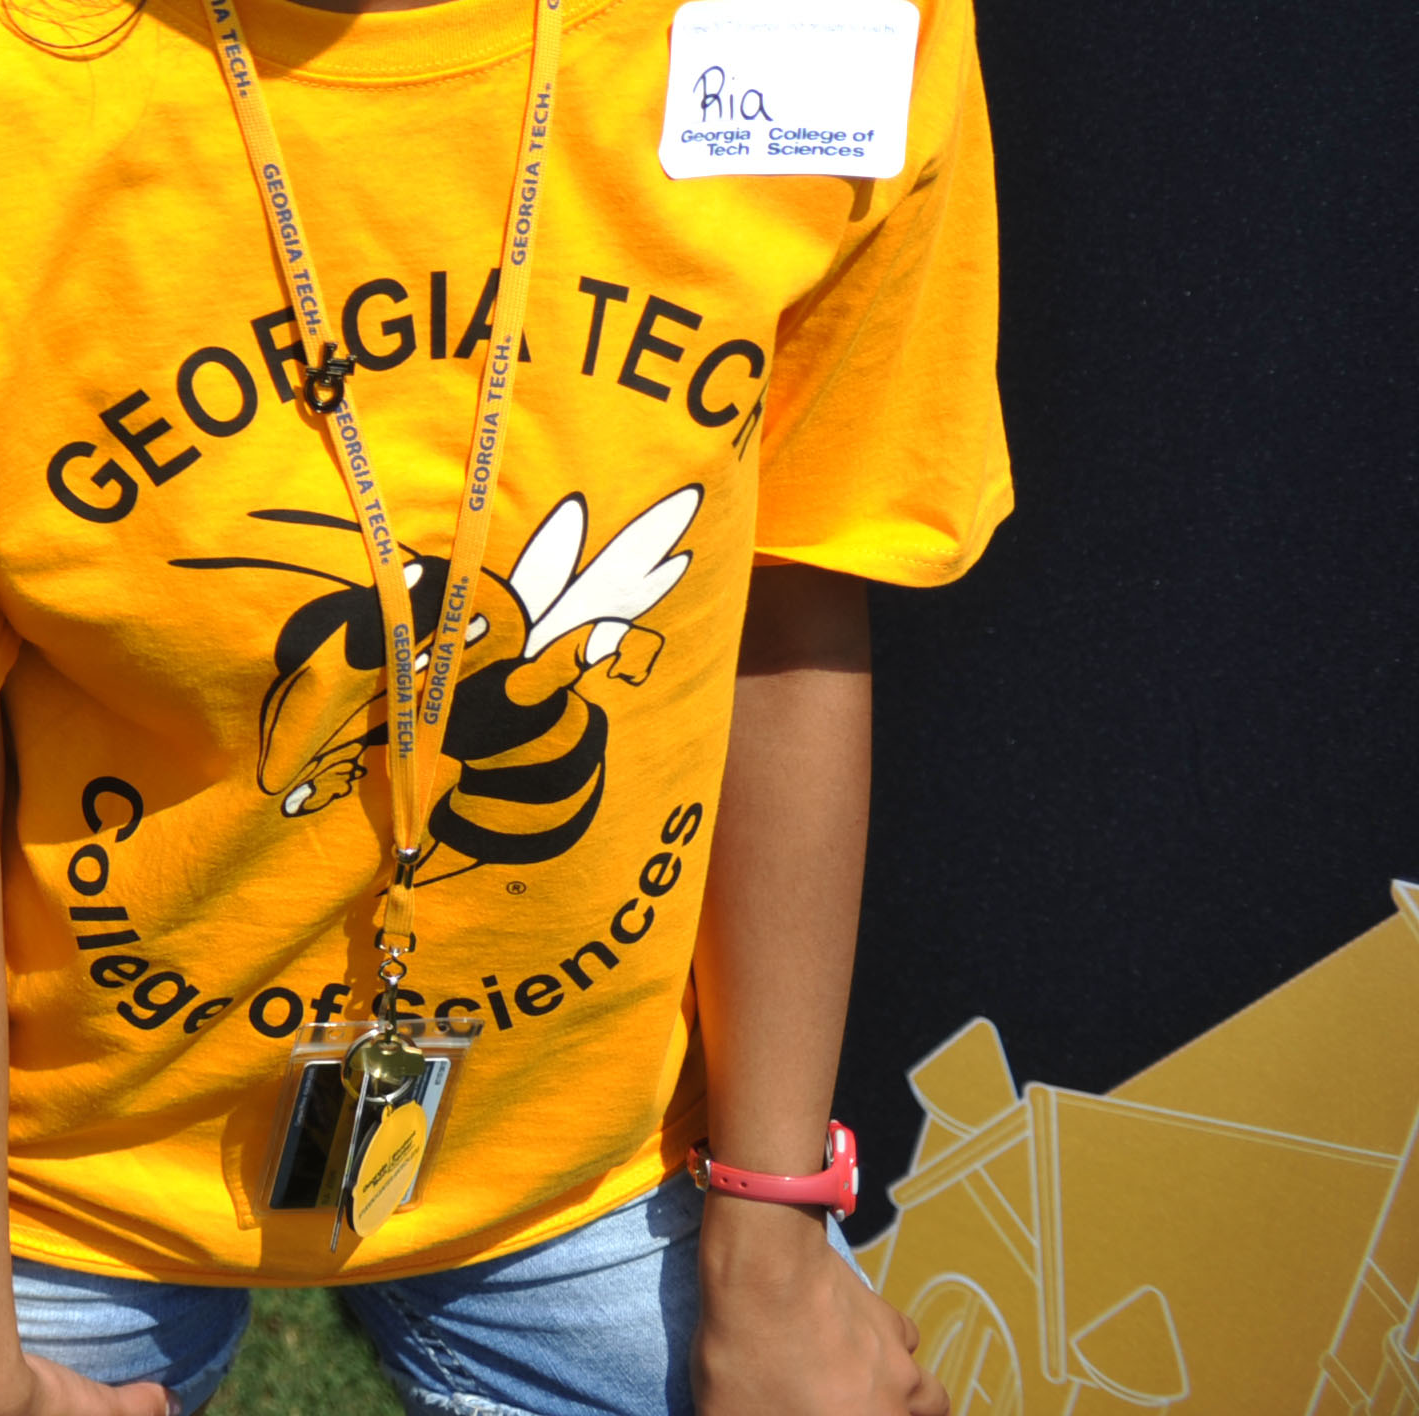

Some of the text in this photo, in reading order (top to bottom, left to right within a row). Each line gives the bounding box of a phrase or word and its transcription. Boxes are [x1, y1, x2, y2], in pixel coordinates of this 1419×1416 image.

[681, 127, 875, 144] Georgia College of
[692, 64, 774, 123] Ria
[706, 142, 865, 158] Tech Sciences
[262, 163, 302, 263] GEORGIA
[511, 160, 542, 267] GEORGIA
[334, 399, 374, 495] GEORGIA
[468, 411, 500, 513] GEORGIA
[393, 623, 414, 704] GEORGIA
[423, 642, 455, 727] GEORGIA
[67, 775, 704, 1039] College of Sciences
